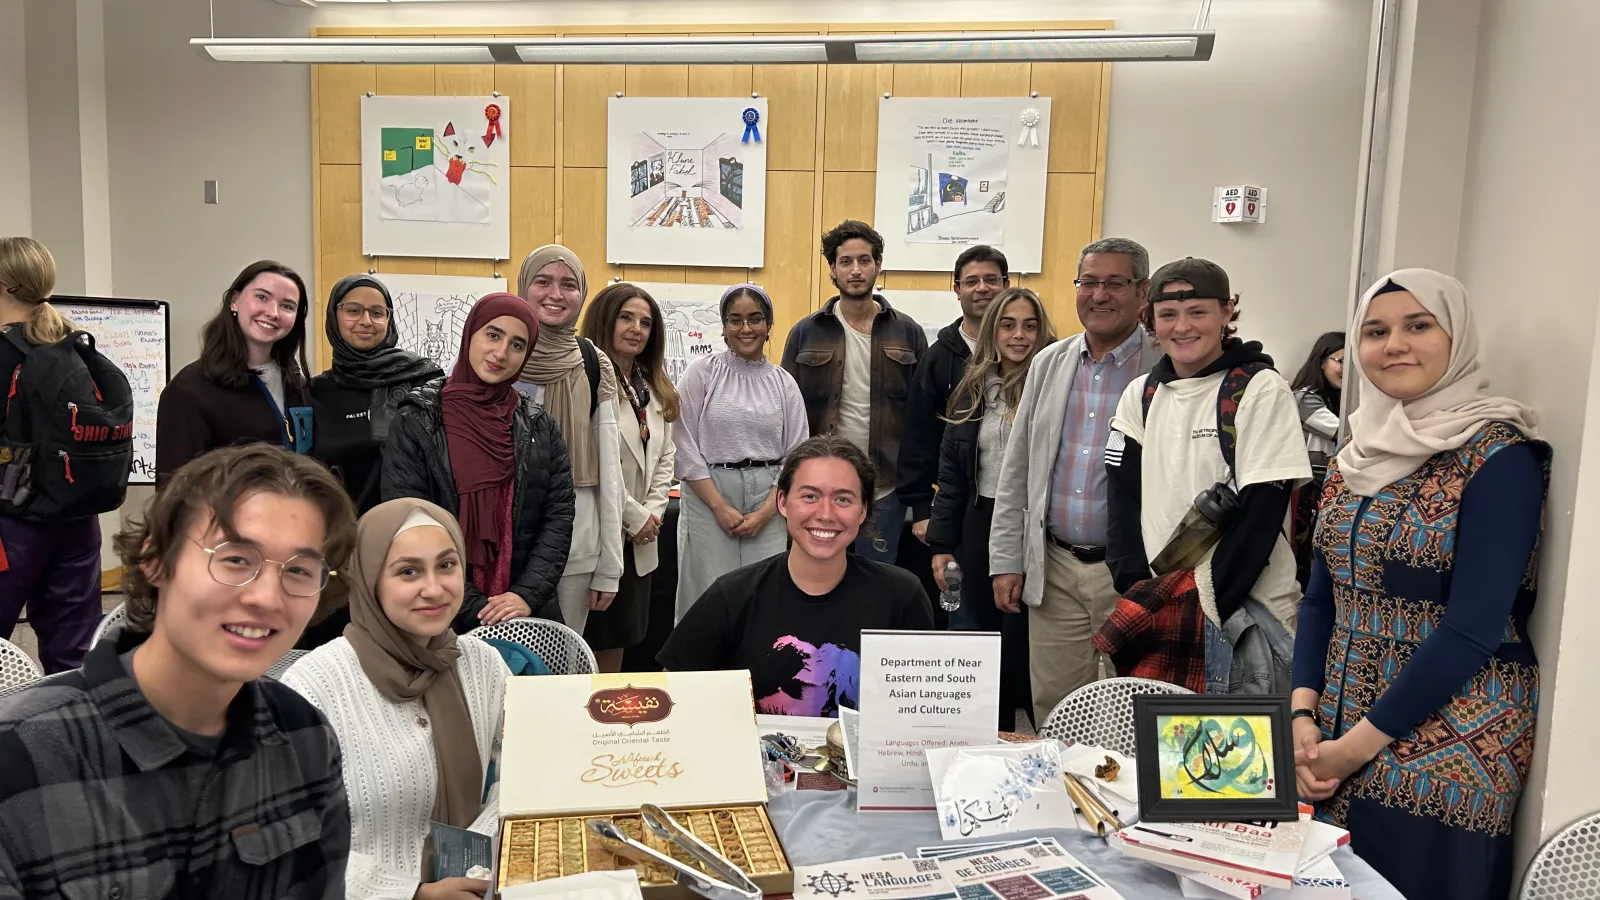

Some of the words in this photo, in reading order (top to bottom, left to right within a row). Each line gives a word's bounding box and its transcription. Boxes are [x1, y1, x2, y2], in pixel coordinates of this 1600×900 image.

[1225, 188, 1239, 196] AED
[1247, 189, 1258, 197] AED
[690, 344, 712, 354] ARMS
[345, 411, 367, 419] PALEST
[74, 425, 109, 441] OHIO
[880, 657, 941, 668] Department
[944, 658, 955, 667] of
[957, 658, 982, 668] Near
[885, 673, 922, 683] Eastern
[925, 673, 944, 683] and
[946, 673, 976, 683] South
[888, 689, 916, 698] Asian
[919, 689, 971, 700] Languages
[898, 705, 917, 714] and
[920, 705, 961, 714] Cultures
[592, 738, 620, 746] Original
[877, 749, 904, 757] Hebrew,
[906, 749, 925, 757] Hindi,
[580, 754, 684, 783] Sweets
[1234, 825, 1272, 838] Baa
[968, 855, 1001, 866] NESA
[955, 867, 976, 878] GE
[975, 857, 1032, 874] COURSES
[861, 871, 893, 880] NESA
[864, 872, 942, 887] LANGUAGES
